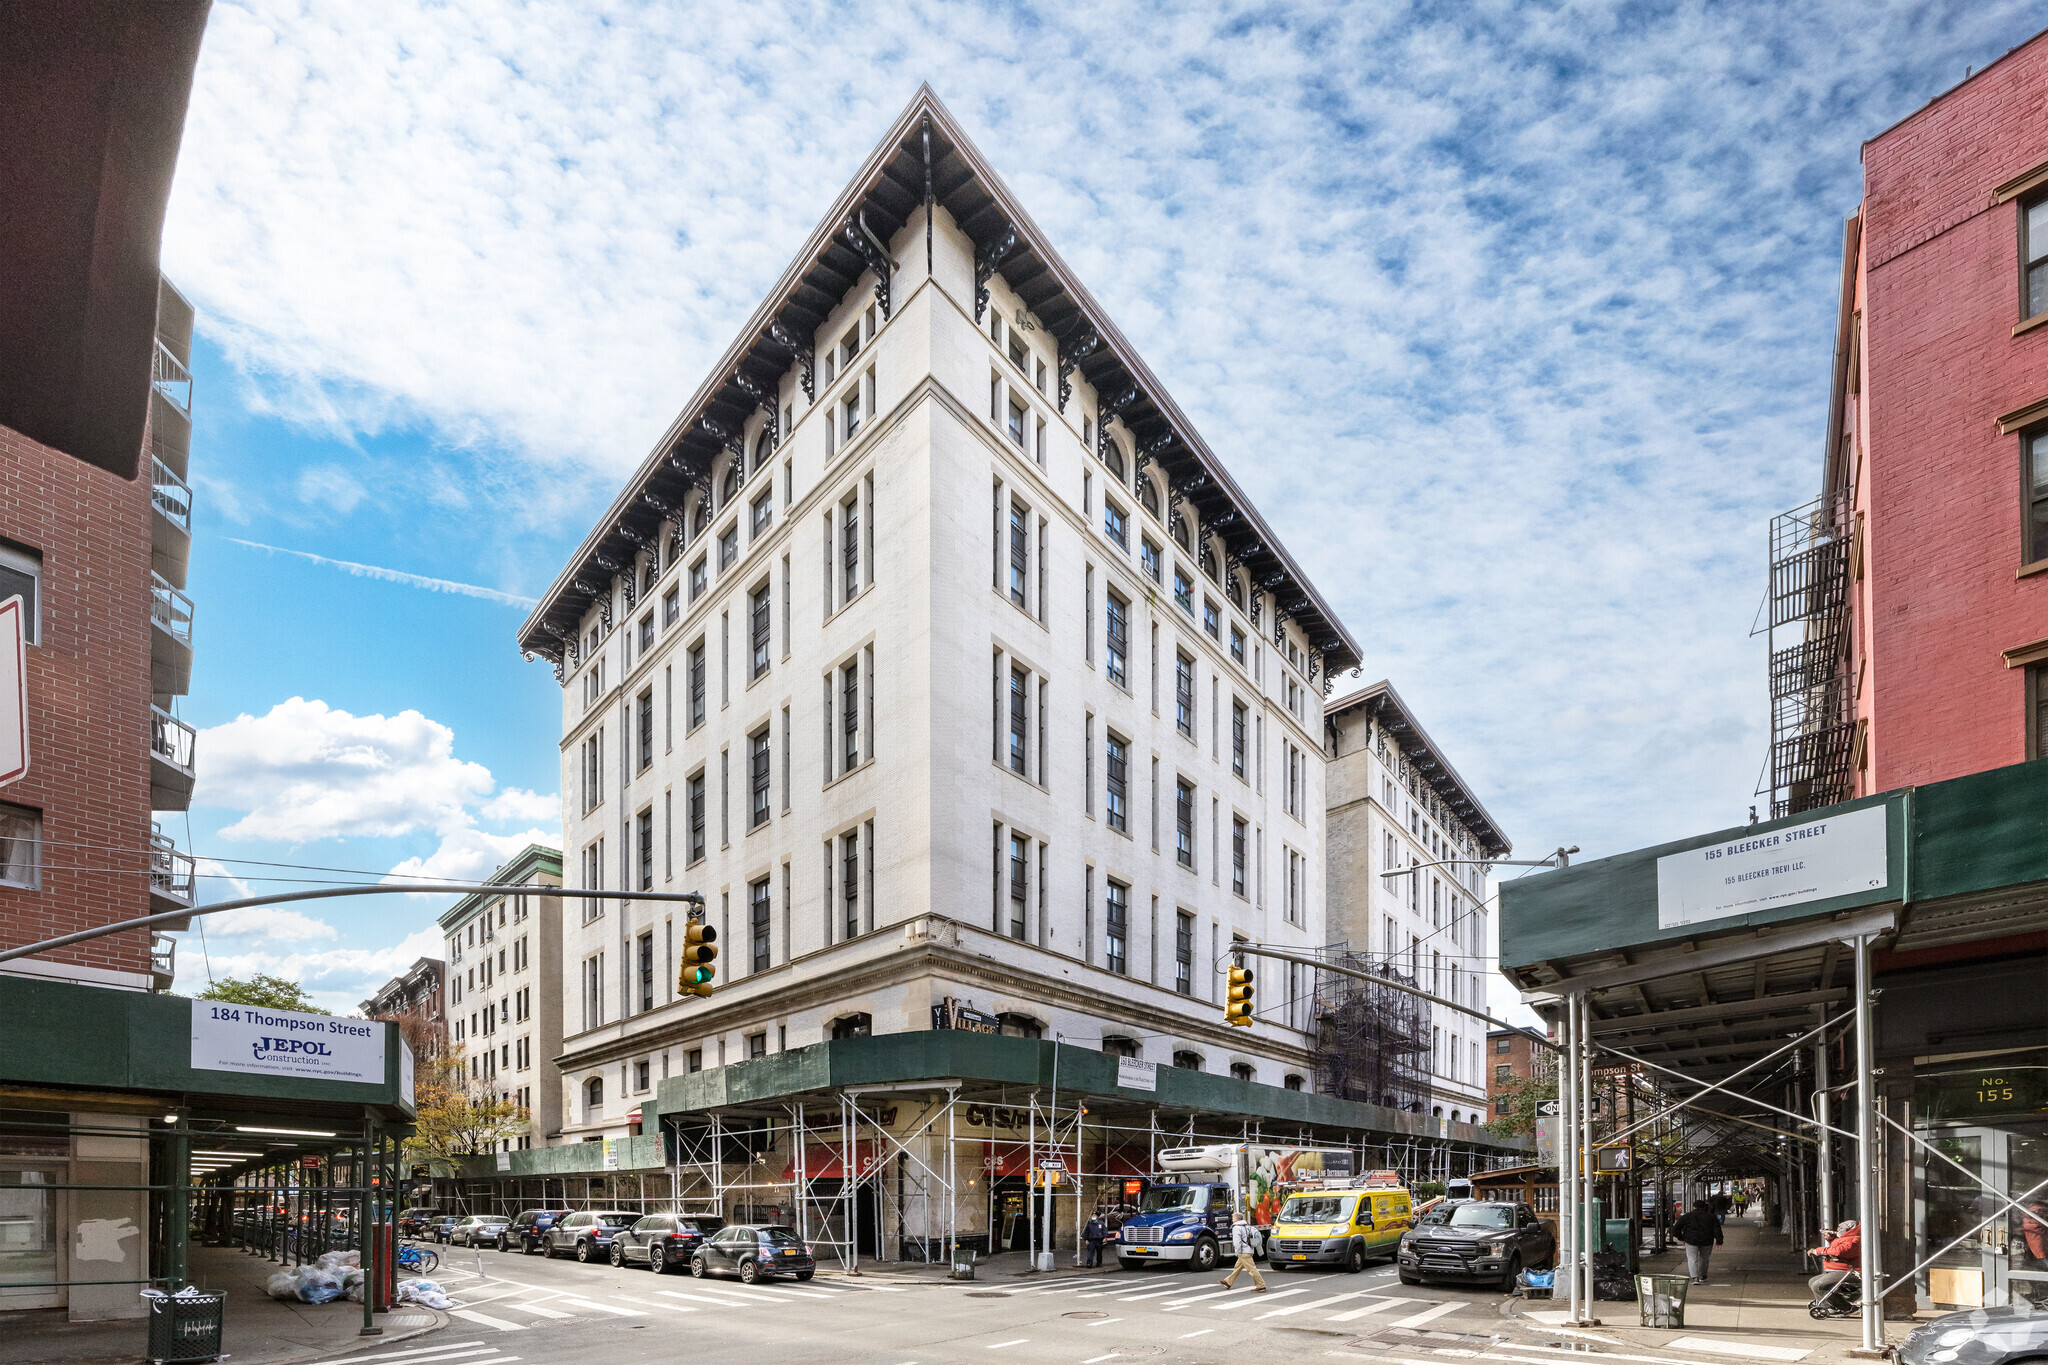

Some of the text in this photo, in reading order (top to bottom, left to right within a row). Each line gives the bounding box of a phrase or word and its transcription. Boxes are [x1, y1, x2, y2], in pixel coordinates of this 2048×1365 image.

[1704, 824, 1827, 861] 155 BLEECKER STREET
[1725, 875, 1736, 885] 155
[1737, 869, 1769, 882] BLEECKER
[1772, 864, 1790, 875] TREVI
[211, 1006, 371, 1037] 184 Thompson Street
[257, 1036, 332, 1056] JEPOL
[253, 1048, 320, 1066] Construction
[1630, 1063, 1641, 1072] St
[1976, 1088, 2013, 1103] 155
